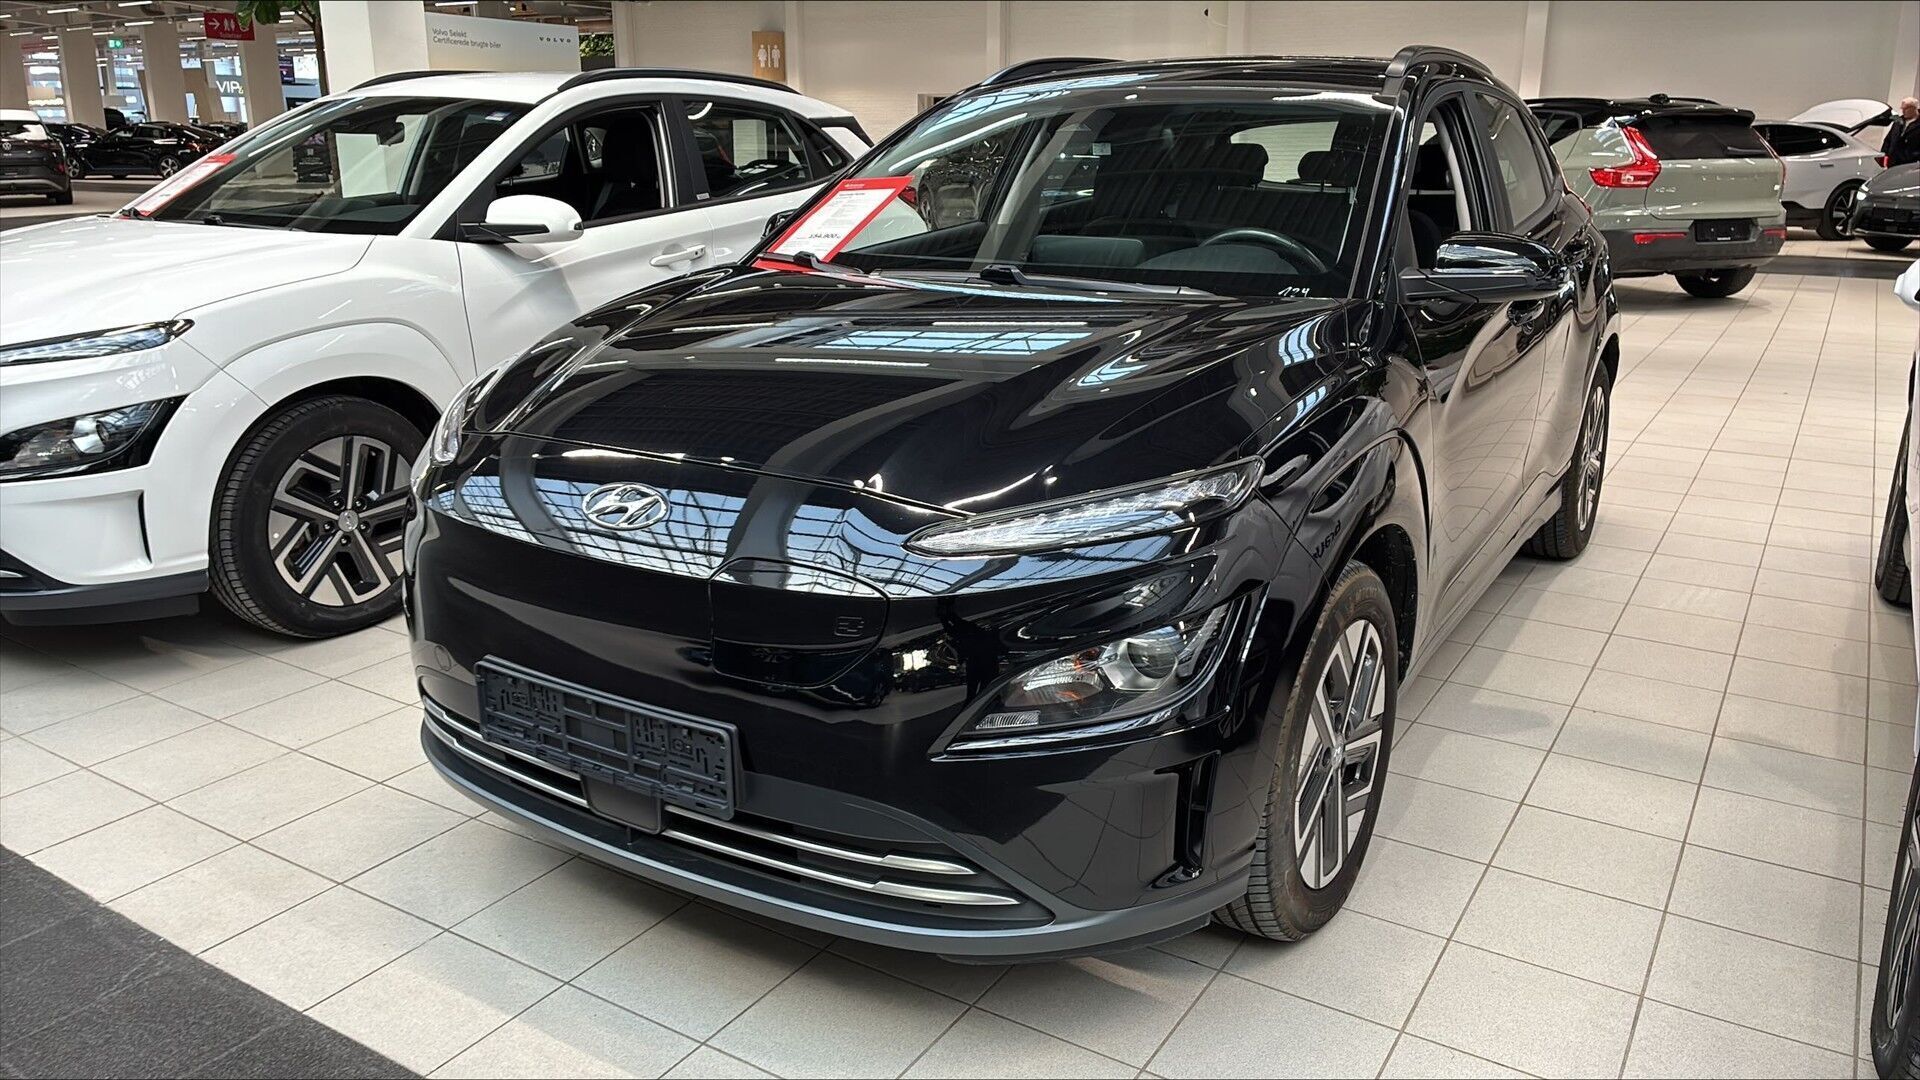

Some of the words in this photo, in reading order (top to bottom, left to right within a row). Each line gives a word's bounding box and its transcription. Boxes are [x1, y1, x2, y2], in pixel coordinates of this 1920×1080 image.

[432, 28, 448, 36] Volvo
[449, 29, 467, 38] Selekt
[432, 36, 469, 47] Certificerede
[470, 39, 488, 49] brugte
[215, 80, 241, 94] VIP
